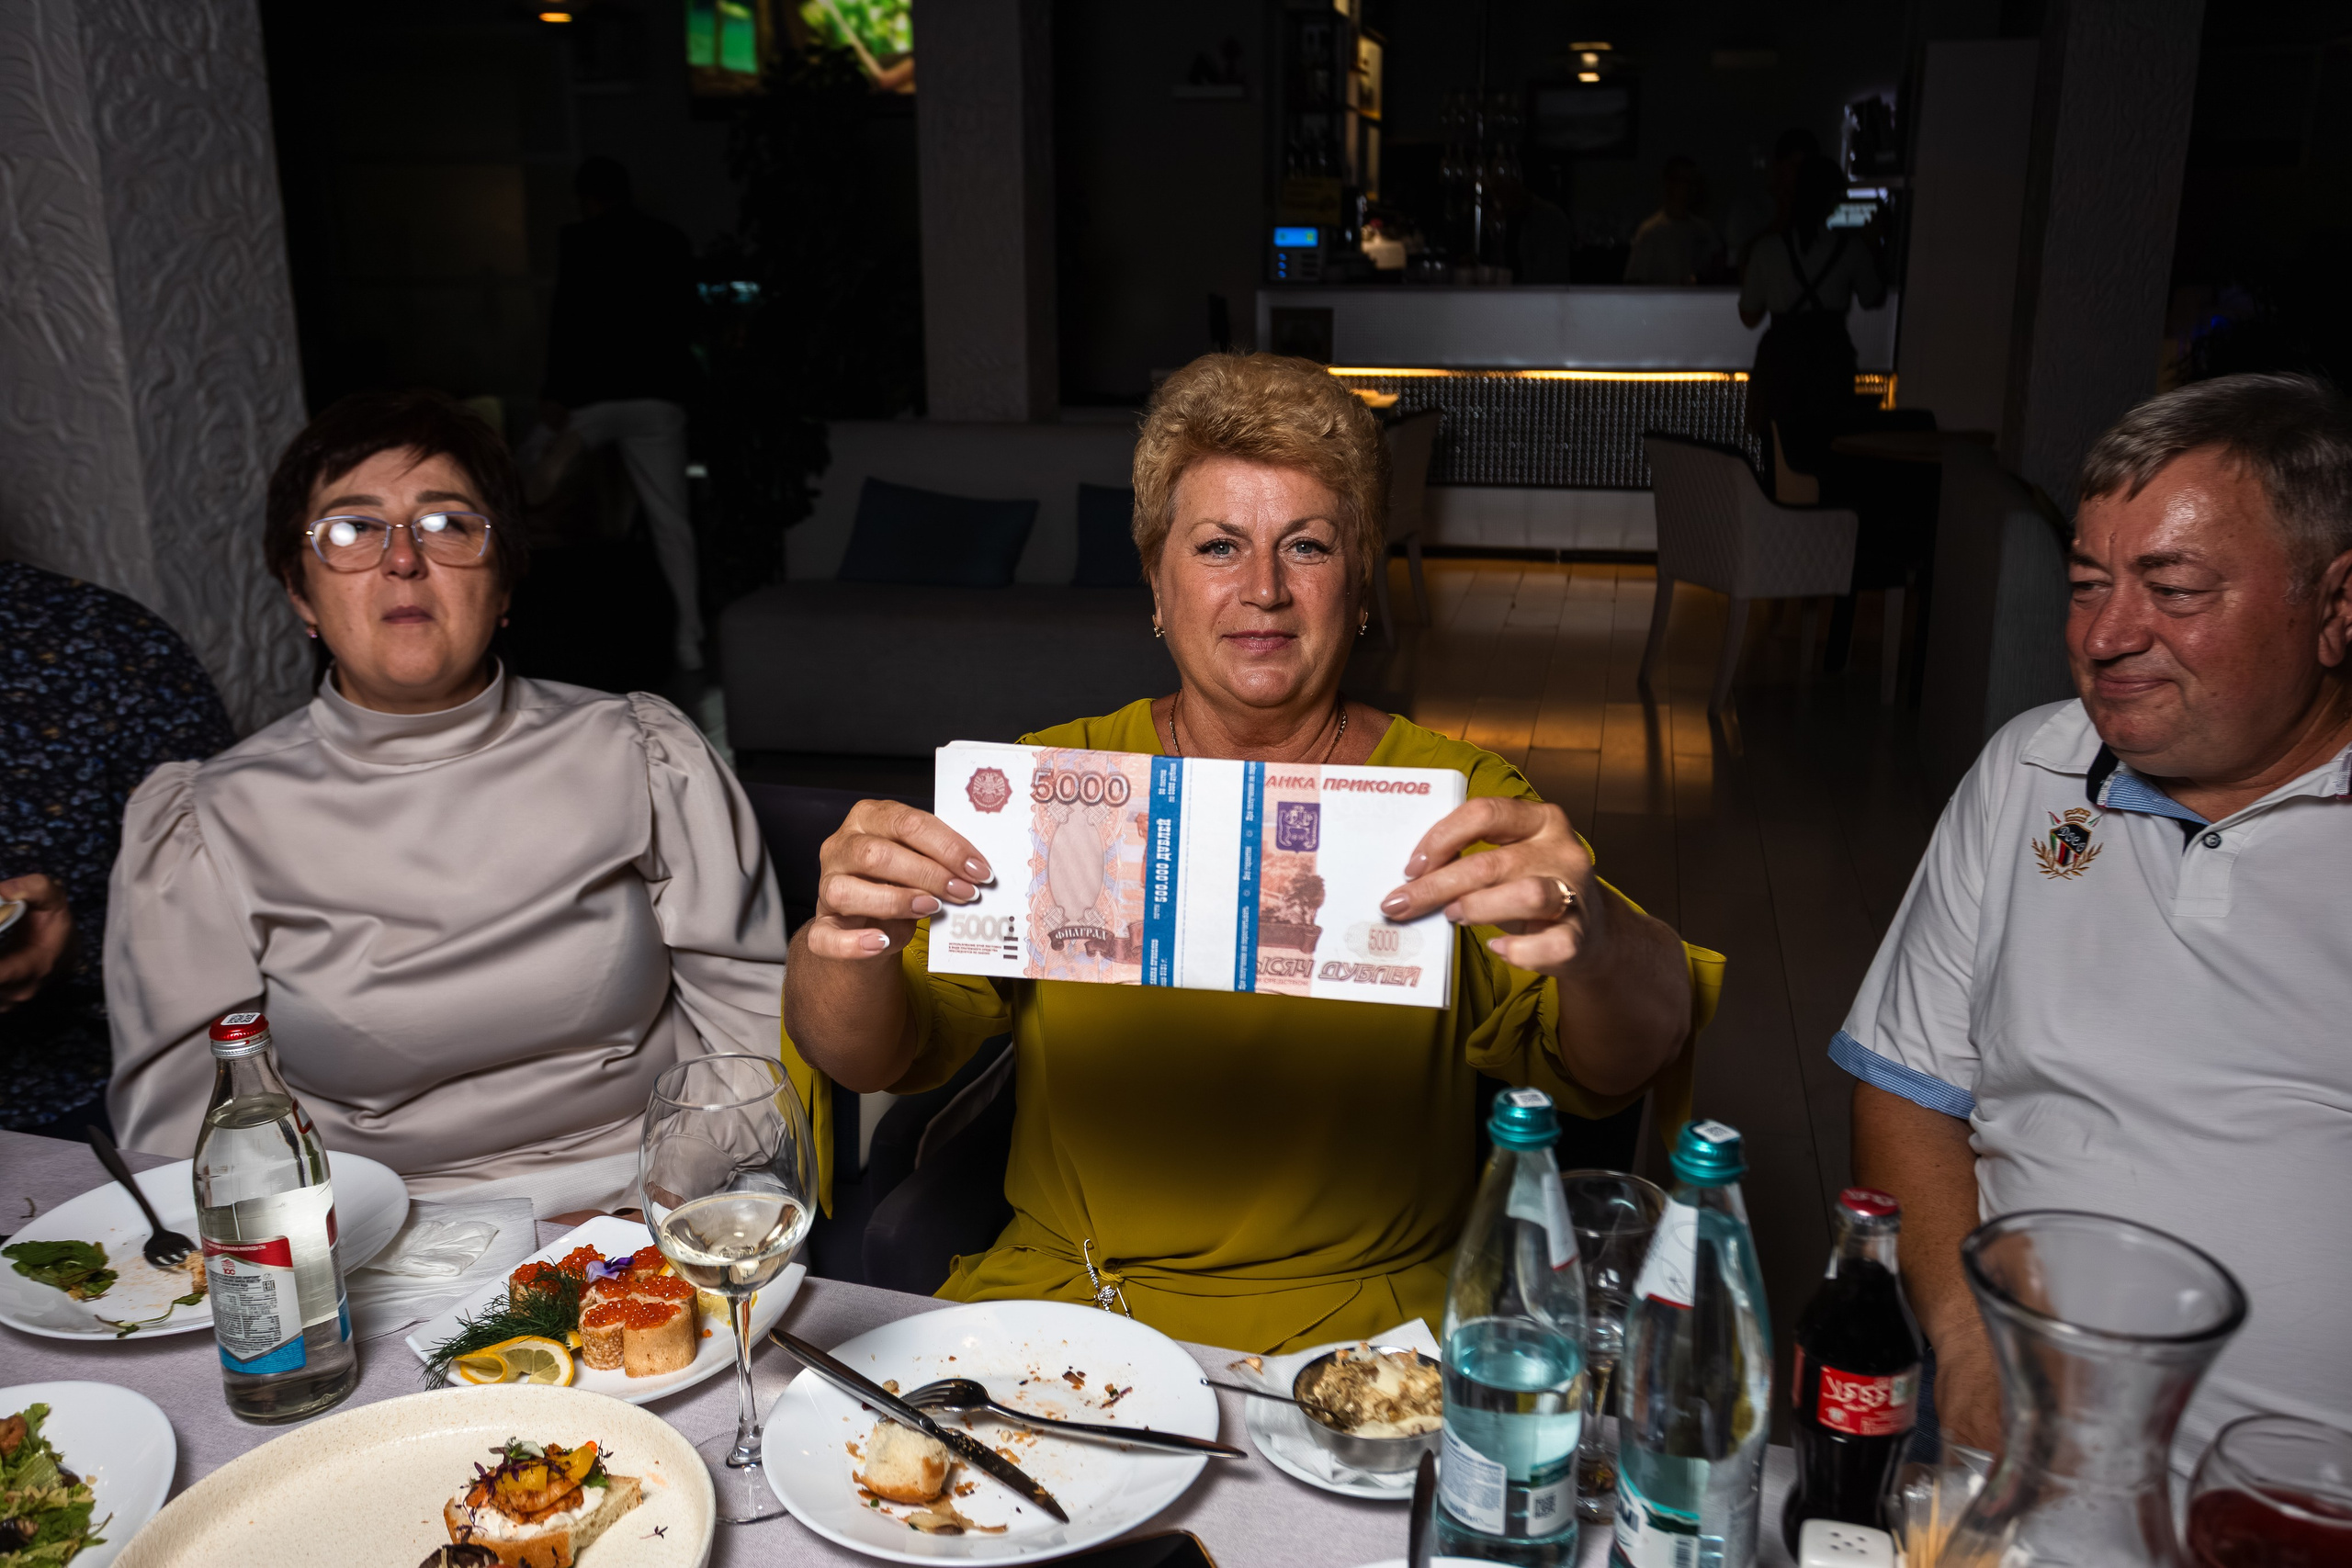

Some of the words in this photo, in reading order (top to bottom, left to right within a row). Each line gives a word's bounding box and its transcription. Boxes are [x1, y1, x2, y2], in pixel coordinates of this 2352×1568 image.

[1030, 768, 1131, 807] 5000
[1266, 775, 1316, 790] АНКА
[1322, 777, 1432, 795] ПРИКОЛОВ
[1156, 818, 1171, 862] ДУБЛЕЙ
[1154, 863, 1170, 903] 500.000
[950, 913, 1014, 942] 5000
[1368, 928, 1399, 953] 5000
[1257, 956, 1315, 977] ЫСЯЧ
[1318, 961, 1423, 987] ДУБЛЕЙ
